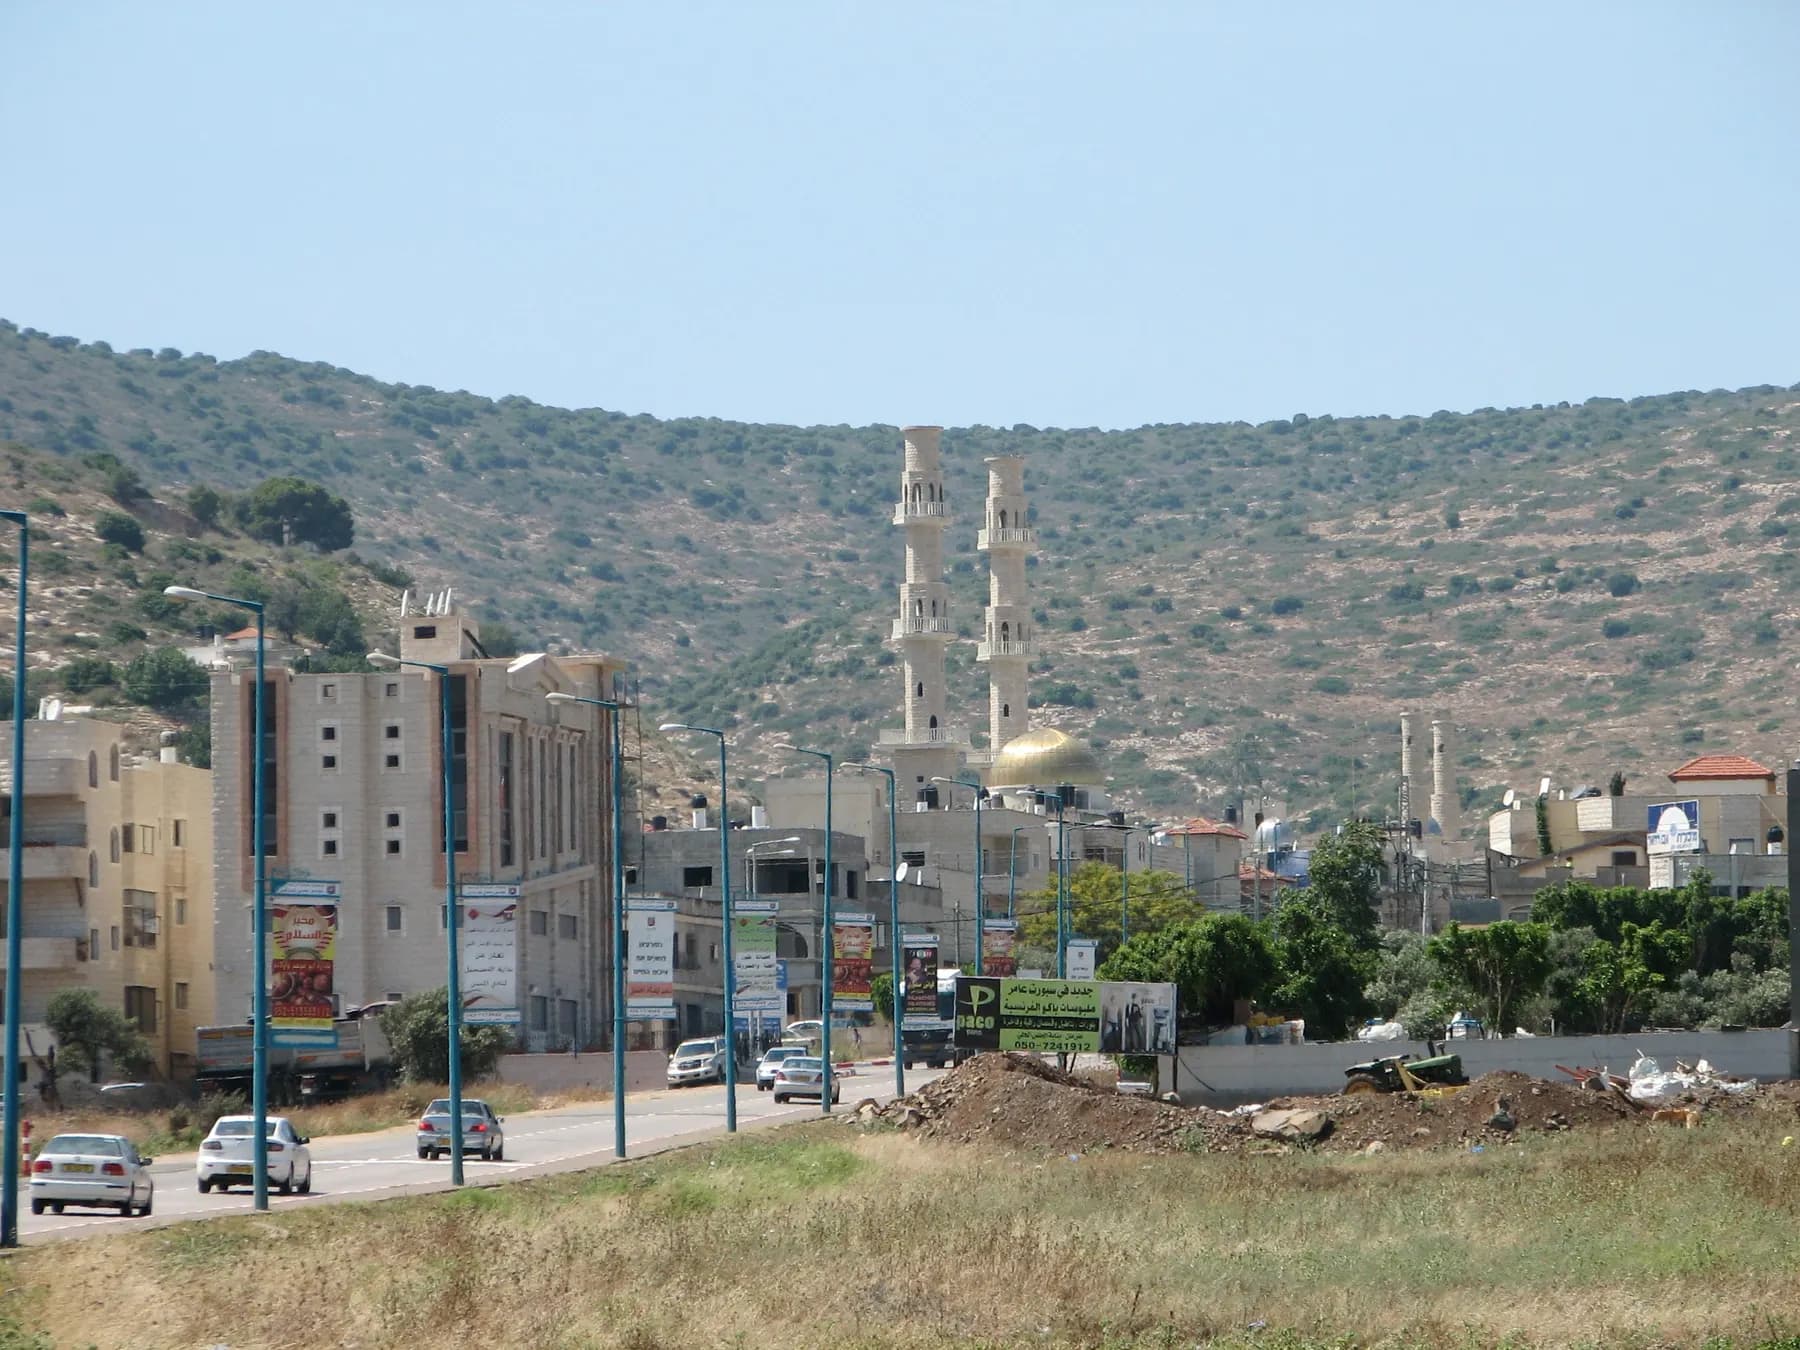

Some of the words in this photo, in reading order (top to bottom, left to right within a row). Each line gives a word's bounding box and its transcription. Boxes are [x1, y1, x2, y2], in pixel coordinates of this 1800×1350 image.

[1007, 983, 1027, 995] عامر
[1028, 983, 1057, 997] سبورت
[1056, 984, 1069, 998] في
[1070, 985, 1093, 998] جديد
[1003, 998, 1041, 1014] الفرنسية
[1060, 1002, 1096, 1016] ملبوسات
[956, 1015, 995, 1031] paco
[1014, 1040, 1091, 1050] 050-7241912
